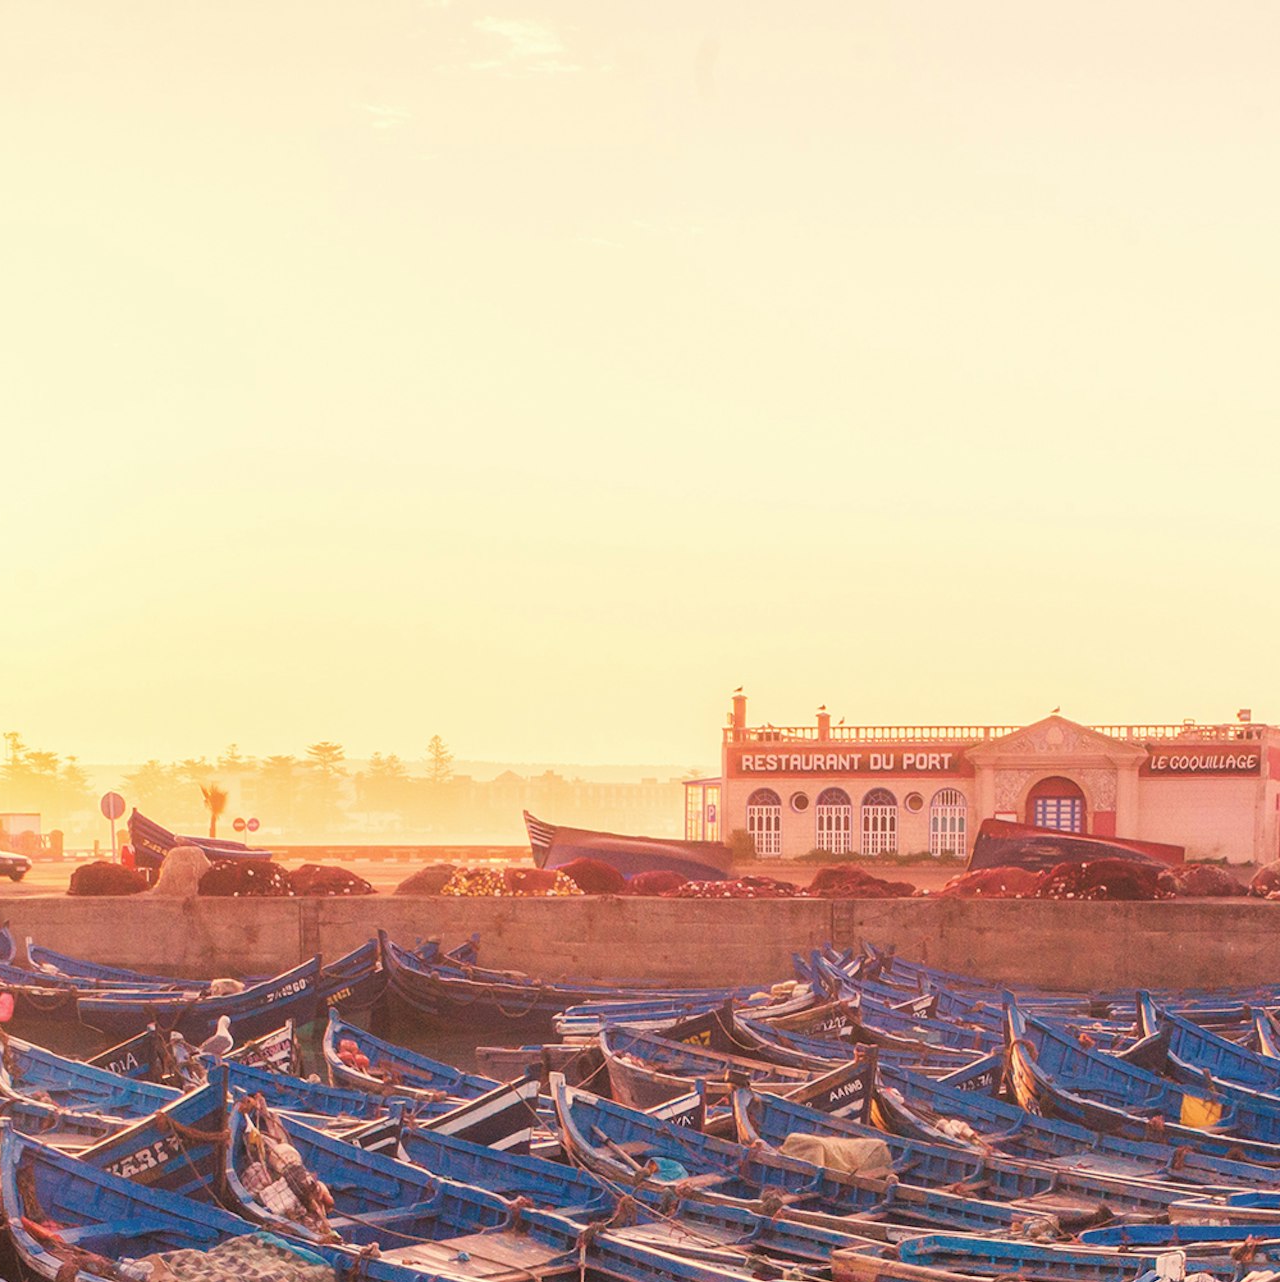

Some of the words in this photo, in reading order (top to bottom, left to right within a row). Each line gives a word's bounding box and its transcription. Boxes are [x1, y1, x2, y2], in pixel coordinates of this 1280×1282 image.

[742, 754, 861, 771] RESTAURANT
[870, 753, 894, 770] DU
[903, 753, 952, 770] PORT
[1151, 755, 1168, 770] LE
[1169, 754, 1258, 771] COQUILLAGE
